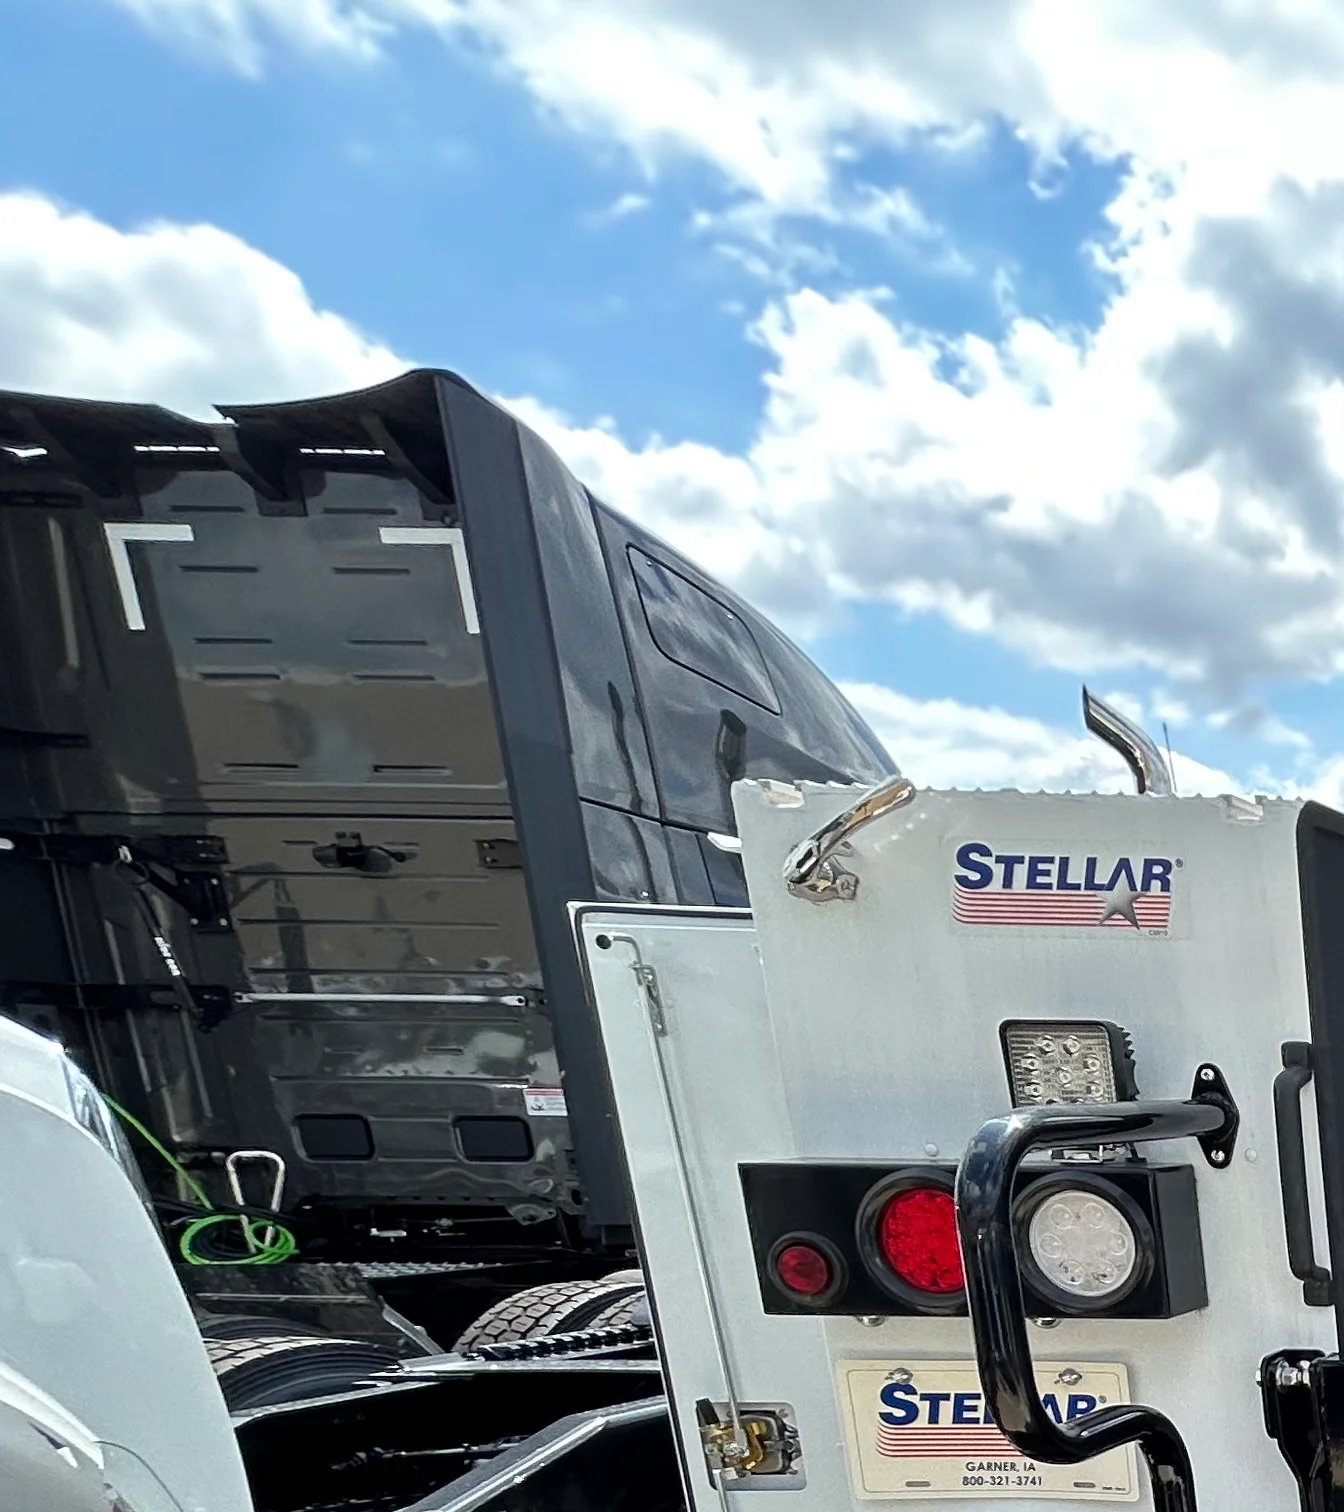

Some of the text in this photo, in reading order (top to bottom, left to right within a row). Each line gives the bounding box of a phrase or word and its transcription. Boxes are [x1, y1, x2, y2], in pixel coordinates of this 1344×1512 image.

[953, 842, 1173, 893] STELLAR
[877, 1382, 1098, 1426] STEAR
[962, 1475, 1042, 1487] 800-321-3741
[965, 1461, 1036, 1473] GARNER, IA
